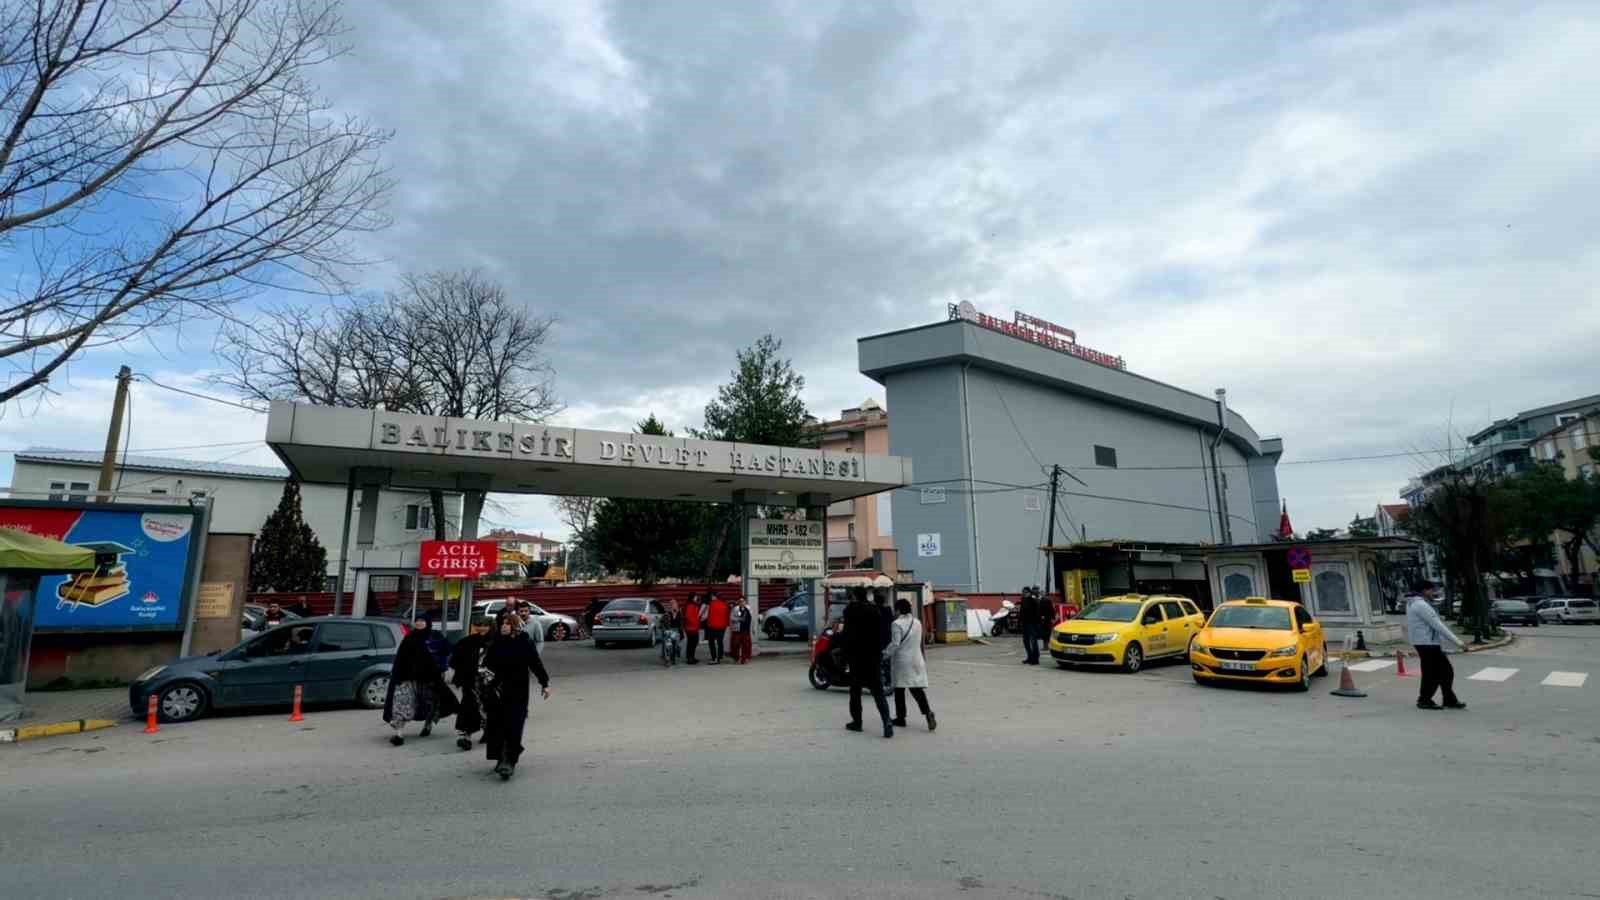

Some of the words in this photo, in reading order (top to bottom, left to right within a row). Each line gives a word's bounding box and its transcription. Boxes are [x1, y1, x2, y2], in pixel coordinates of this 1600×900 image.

[380, 422, 573, 459] BALIKESİR
[599, 440, 710, 467] DEVLET
[729, 451, 860, 478] HASTANESİ
[767, 523, 789, 537] MHRS
[437, 542, 480, 556] ACİL
[427, 555, 486, 572] GİRİŞİ
